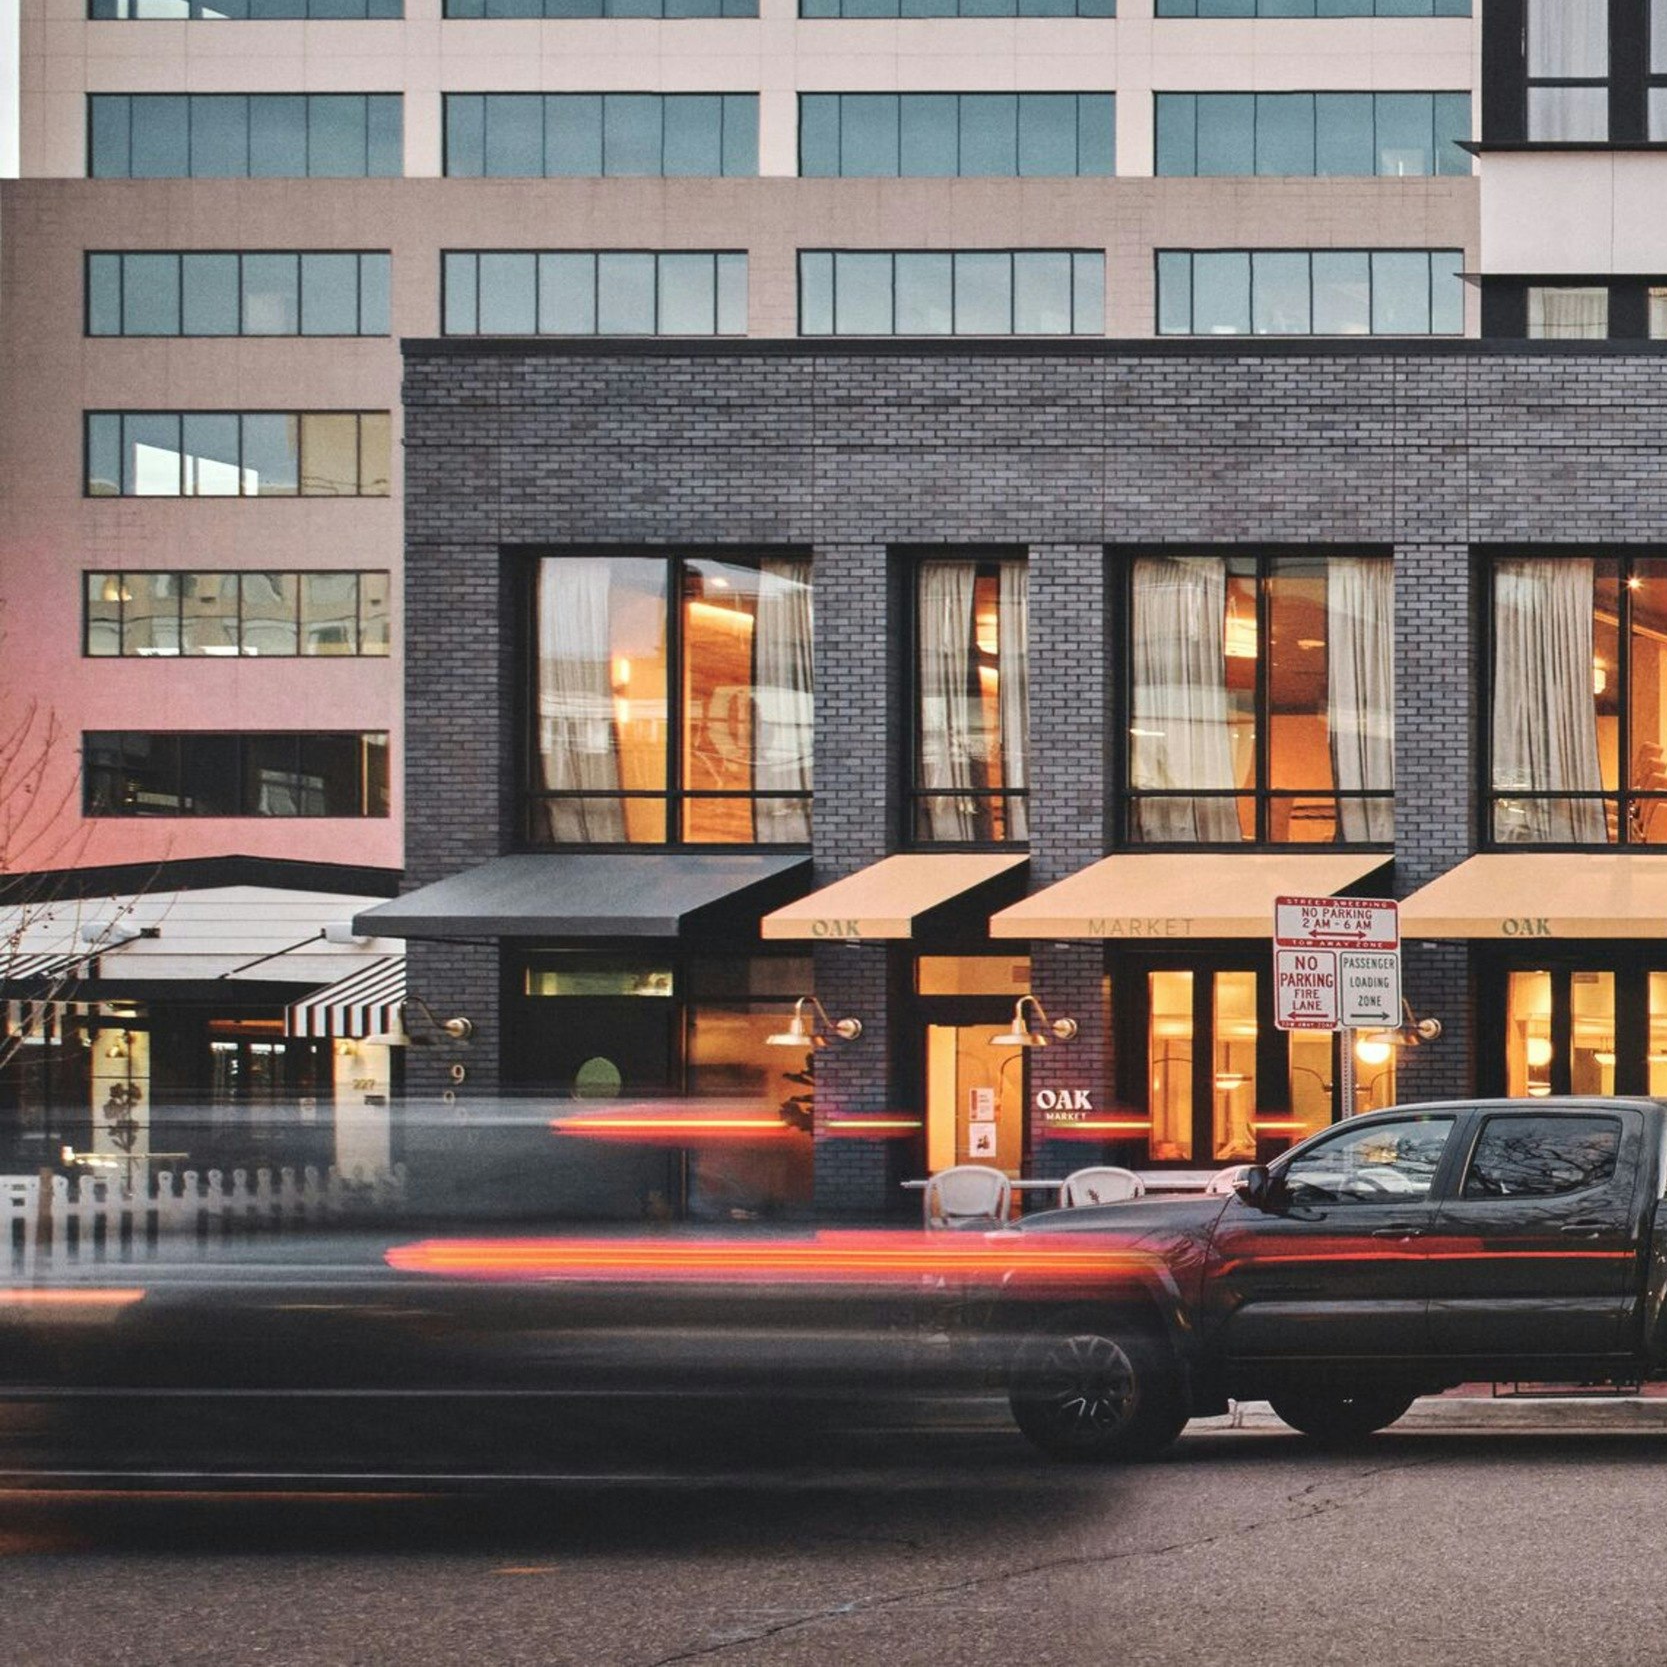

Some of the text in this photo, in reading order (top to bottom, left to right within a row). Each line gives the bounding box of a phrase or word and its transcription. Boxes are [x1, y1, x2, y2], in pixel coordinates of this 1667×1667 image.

[1302, 907, 1372, 919] NO PARKING
[812, 919, 860, 936] OAK
[1088, 918, 1194, 936] MARKET
[1302, 918, 1310, 928] 2
[1314, 919, 1330, 929] AM
[1344, 920, 1351, 929] 6
[1356, 920, 1372, 930] AM
[1502, 918, 1551, 936] OAK
[1295, 956, 1318, 970] NO
[1343, 957, 1395, 970] PASSENGER
[1280, 973, 1333, 988] PARKING
[1350, 977, 1389, 988] LOADING
[1294, 989, 1320, 999] FIRE
[1292, 1000, 1322, 1011] LANE
[1358, 996, 1381, 1006] ZONE
[452, 1064, 465, 1084] 9
[1036, 1089, 1093, 1110] OAK
[1046, 1112, 1087, 1121] MARKET
